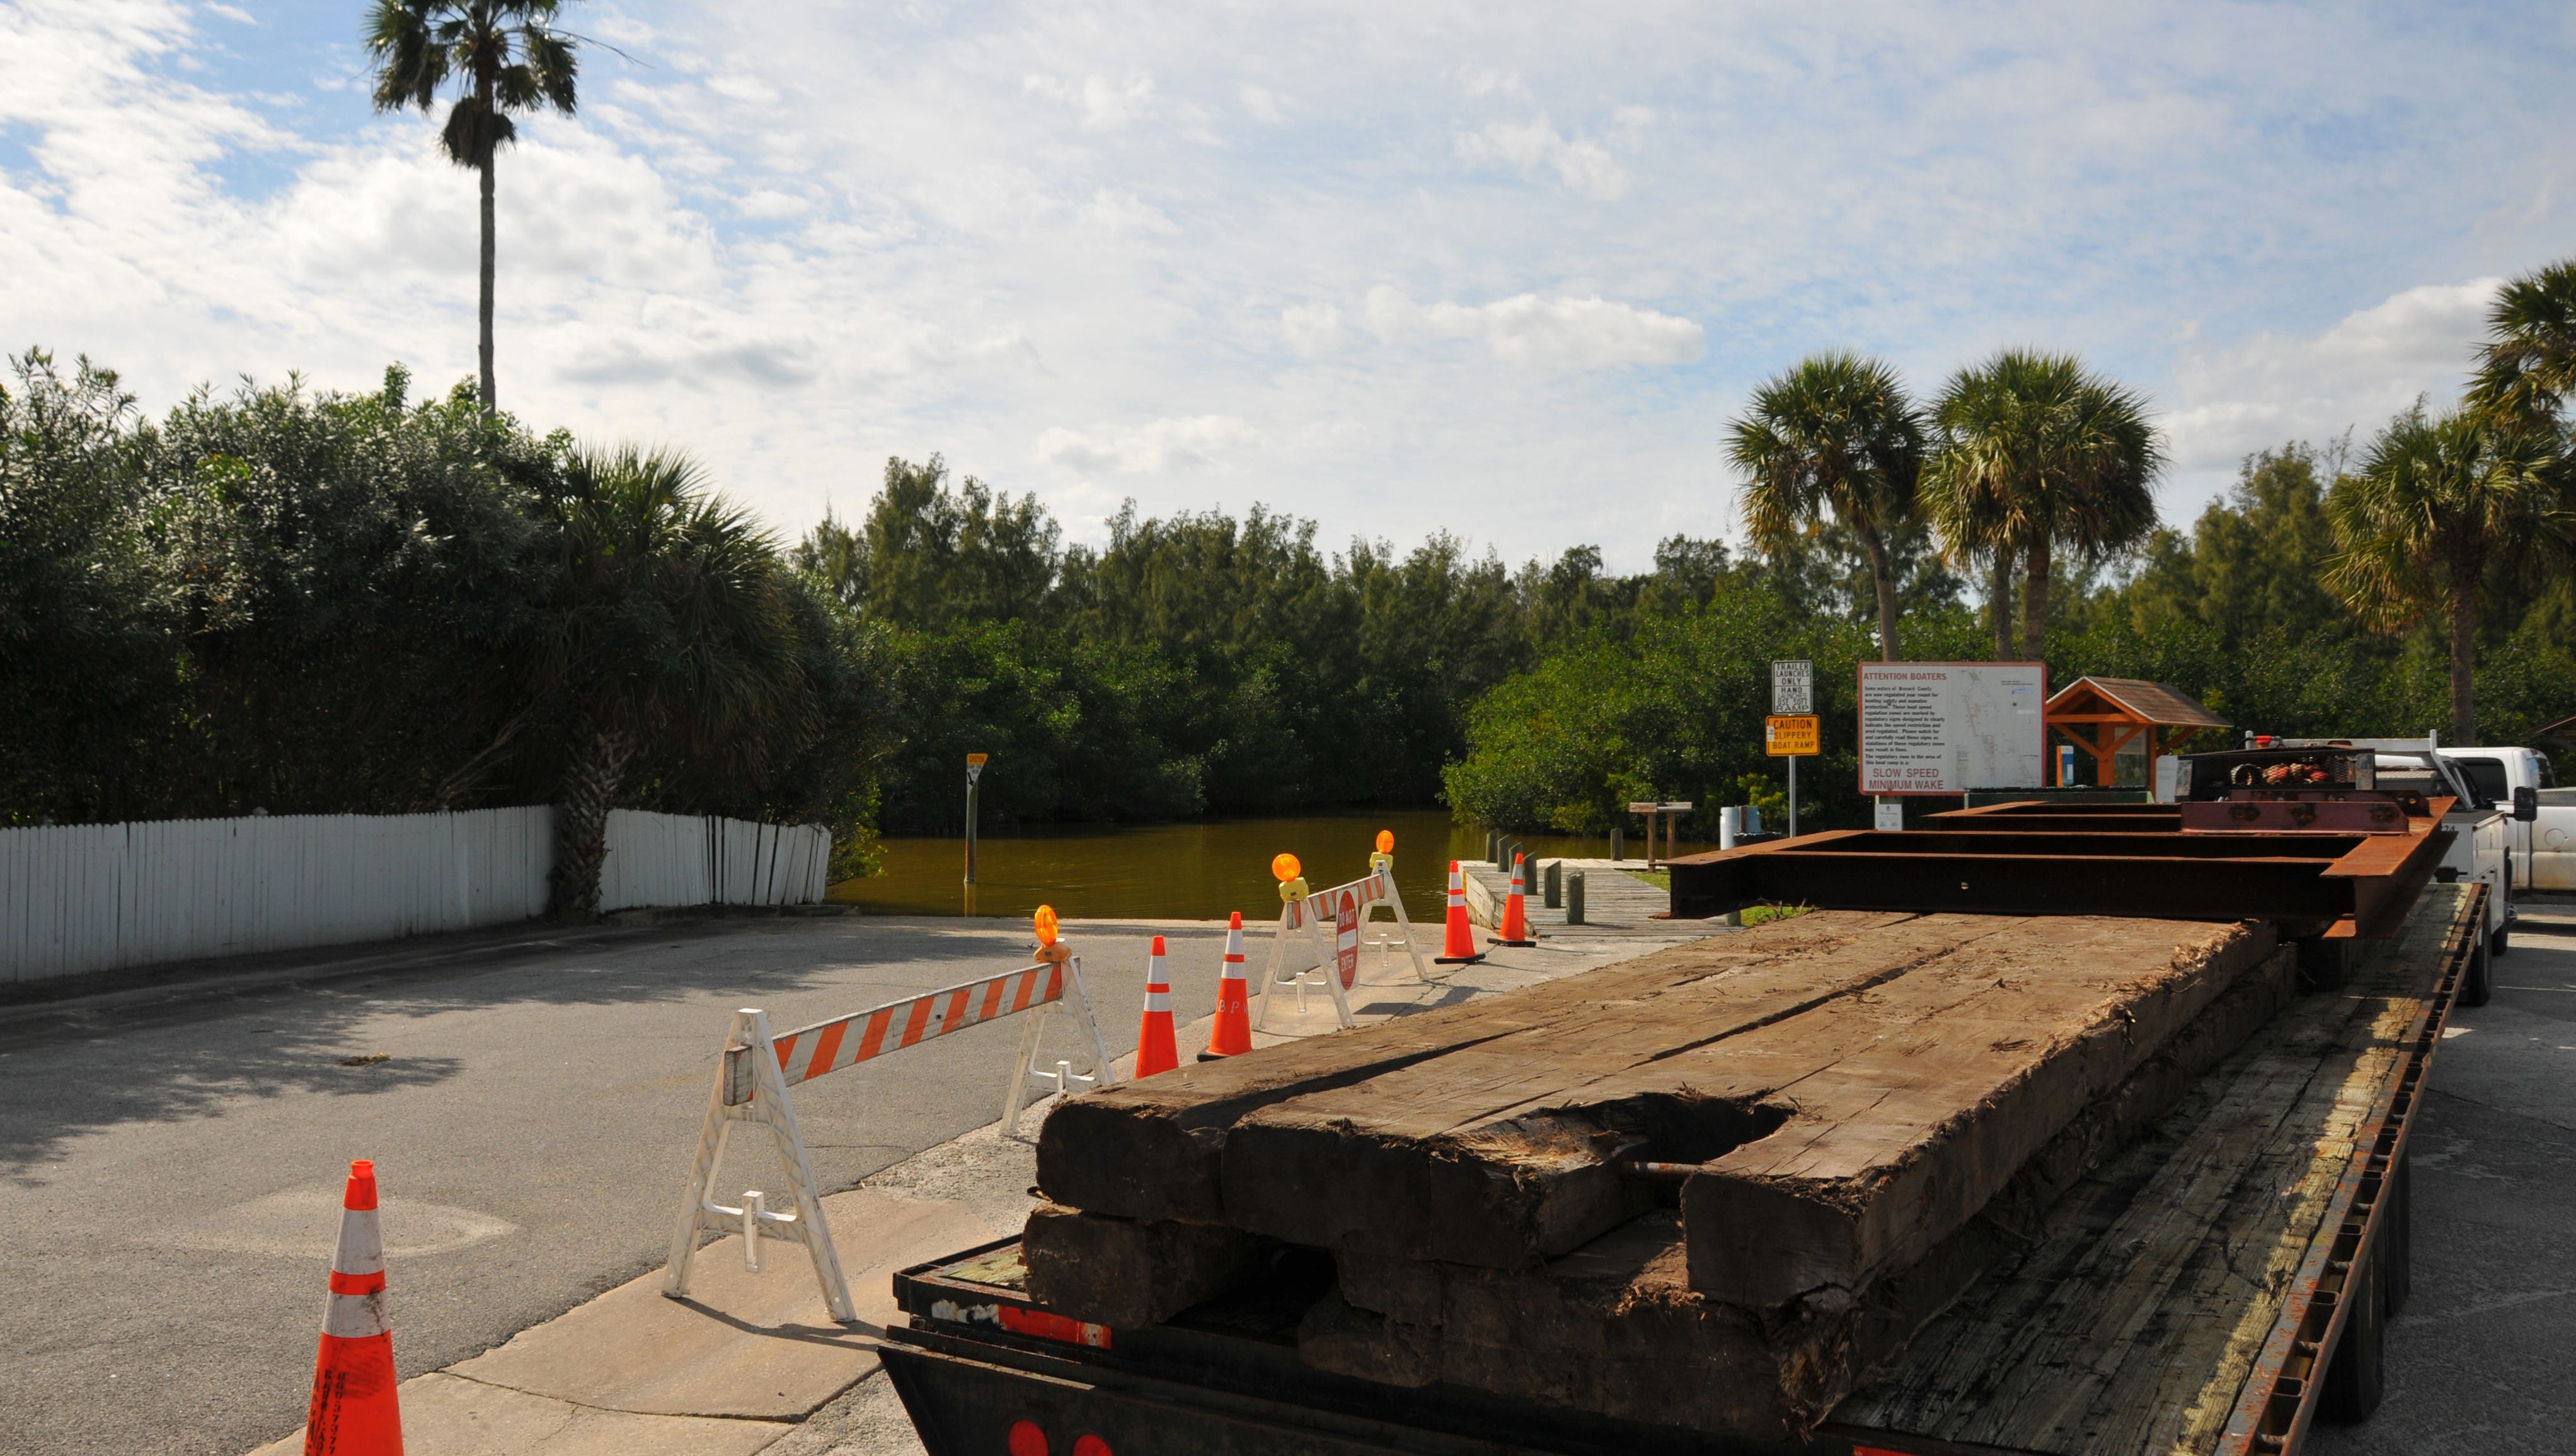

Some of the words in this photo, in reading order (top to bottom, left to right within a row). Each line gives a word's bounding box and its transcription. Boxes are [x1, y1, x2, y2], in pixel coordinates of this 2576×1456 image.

[1773, 719, 1812, 730] CAUTION
[1873, 768, 1902, 778] SLOW
[1906, 768, 1939, 778] SPEED
[1869, 780, 1912, 790] MINIMUM
[1914, 780, 1944, 790] WAKE
[1339, 911, 1346, 928] DO
[1346, 908, 1355, 925] NOT
[1341, 953, 1354, 973] ENTER
